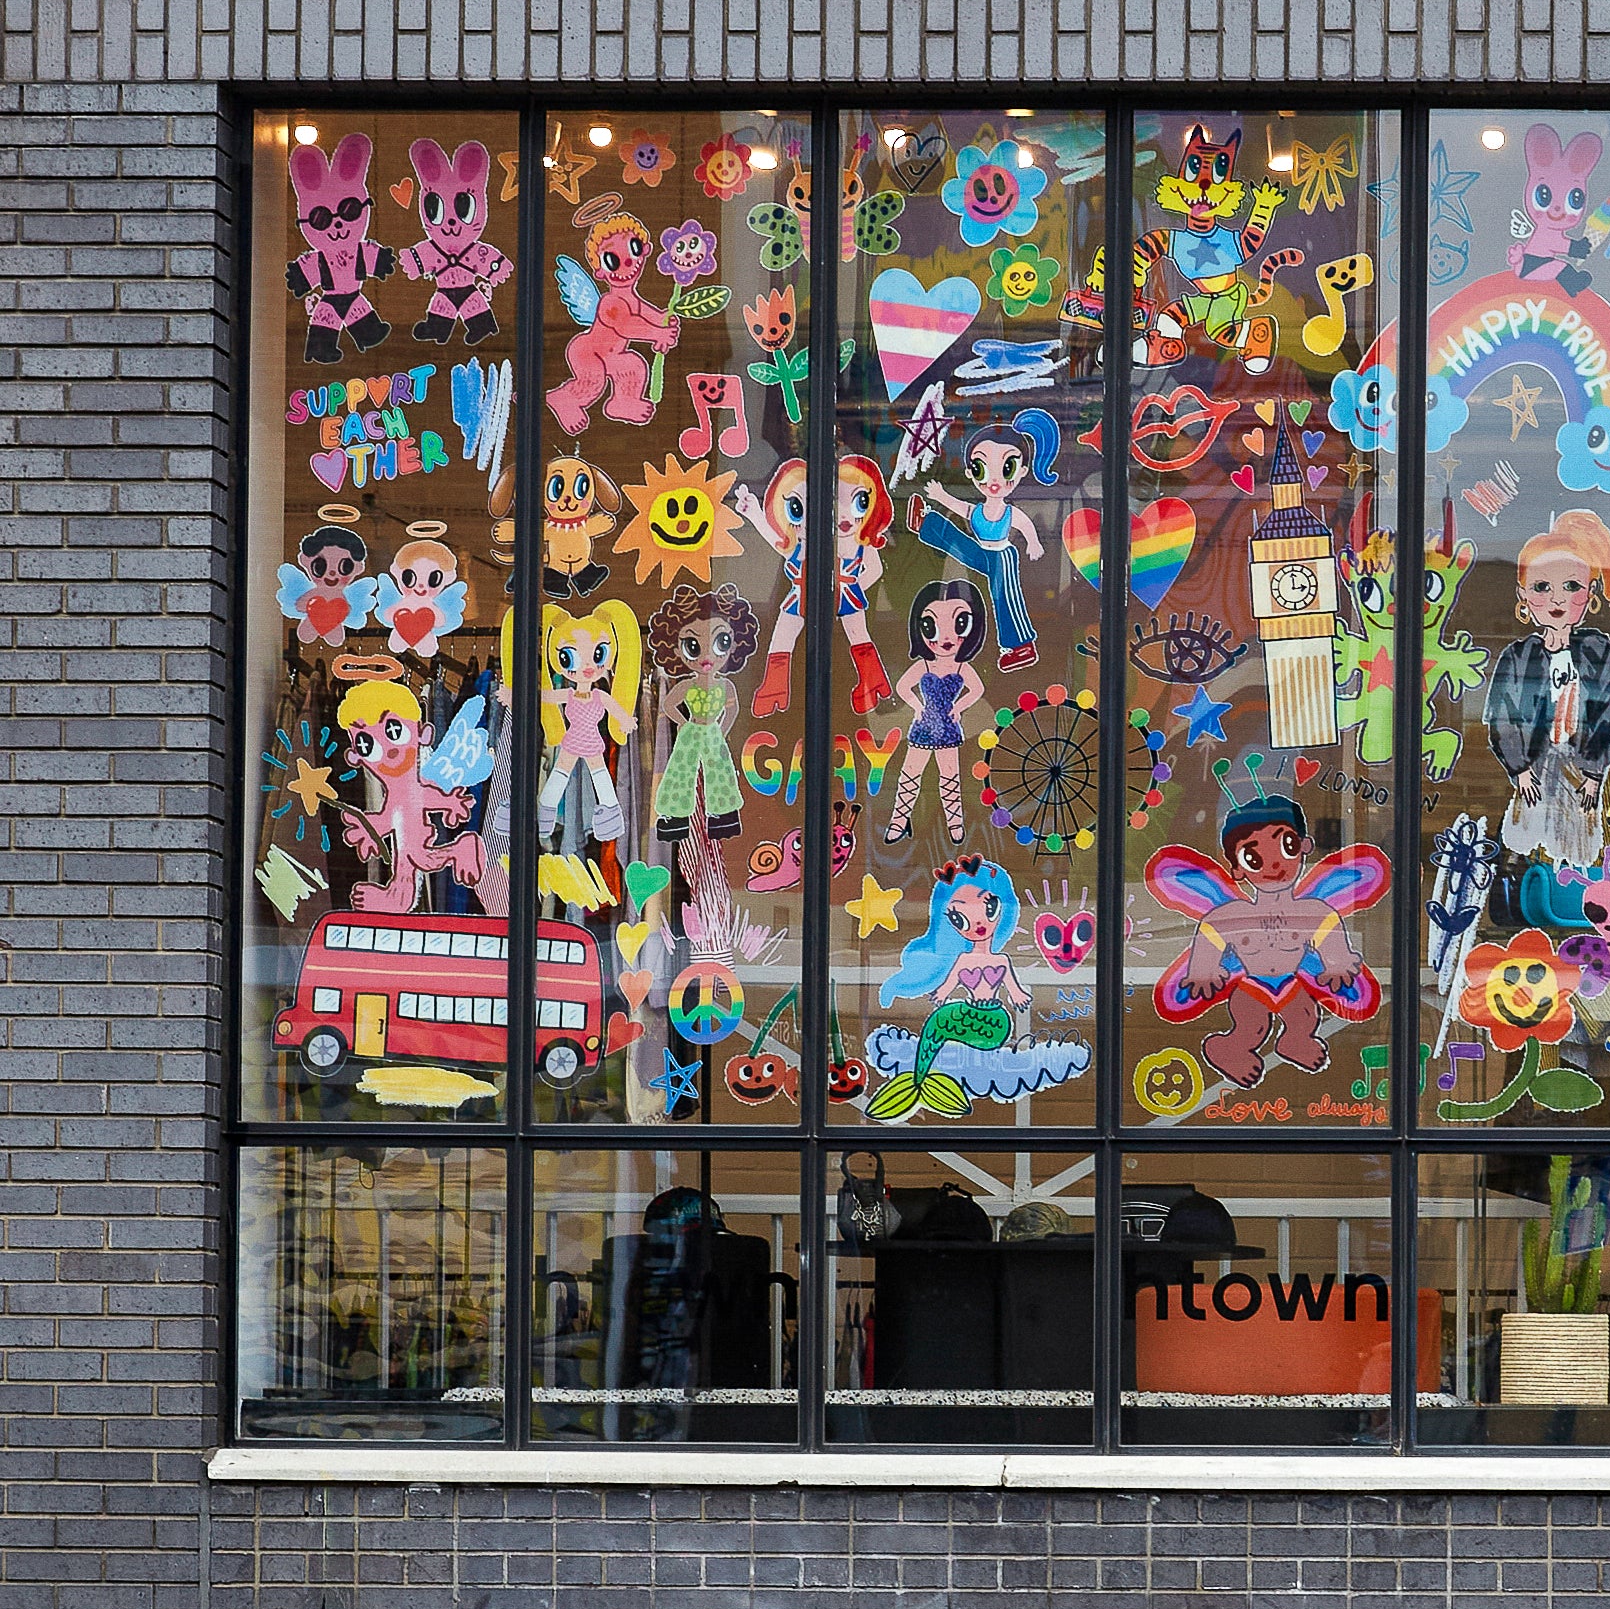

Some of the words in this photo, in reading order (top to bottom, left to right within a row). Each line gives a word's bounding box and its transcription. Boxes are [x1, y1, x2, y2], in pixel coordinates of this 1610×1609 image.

[1438, 299, 1547, 376] HAPPY
[320, 407, 409, 449] EACH
[741, 727, 902, 806] GAY
[1204, 1088, 1292, 1123] Love
[1306, 1093, 1389, 1127] always
